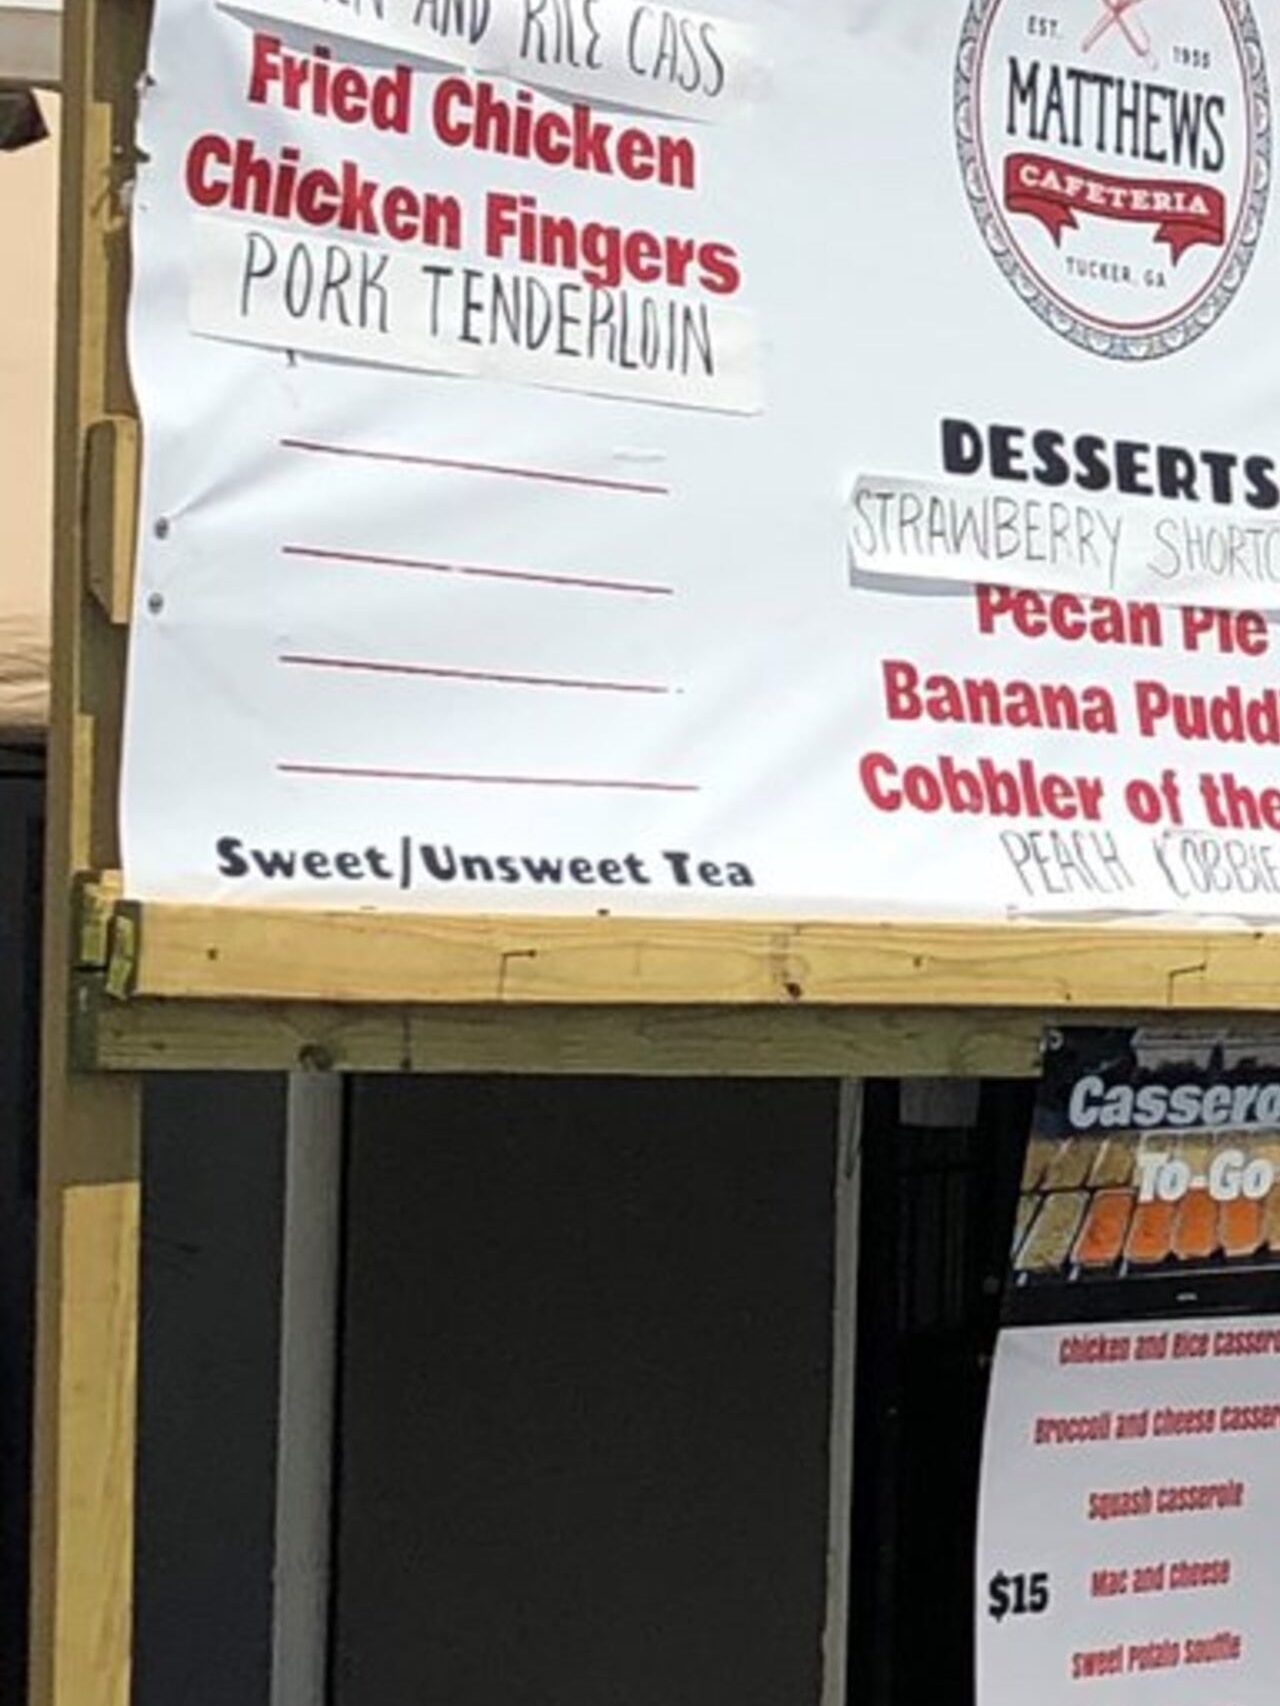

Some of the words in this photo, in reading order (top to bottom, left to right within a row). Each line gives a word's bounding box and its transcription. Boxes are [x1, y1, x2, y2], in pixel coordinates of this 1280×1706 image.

[627, 13, 727, 98] CASS
[248, 32, 411, 134] Fried
[433, 78, 696, 189] Chicken
[1006, 56, 1226, 173] MATTHEWS
[184, 135, 461, 250] Chicken
[485, 191, 741, 295] Fingers
[1019, 165, 1210, 216] CAFETERIA
[240, 233, 391, 334] PORK
[422, 265, 715, 378] TENDERLOIN
[1144, 269, 1166, 288] GA
[853, 488, 1122, 590] STRAWBERRY
[975, 583, 1162, 647] Pecan
[1182, 606, 1269, 656] Pie
[881, 660, 1117, 734] Banana
[859, 751, 1105, 821] Cobbler
[1125, 771, 1183, 826] of
[215, 836, 646, 889] Sweet/Unsweet
[662, 850, 755, 889] Tea
[1000, 829, 1136, 896] PEACH
[1134, 1332, 1167, 1360] and
[1116, 1410, 1148, 1439] and
[988, 1570, 1050, 1622] $15
[1133, 1563, 1165, 1593] and
